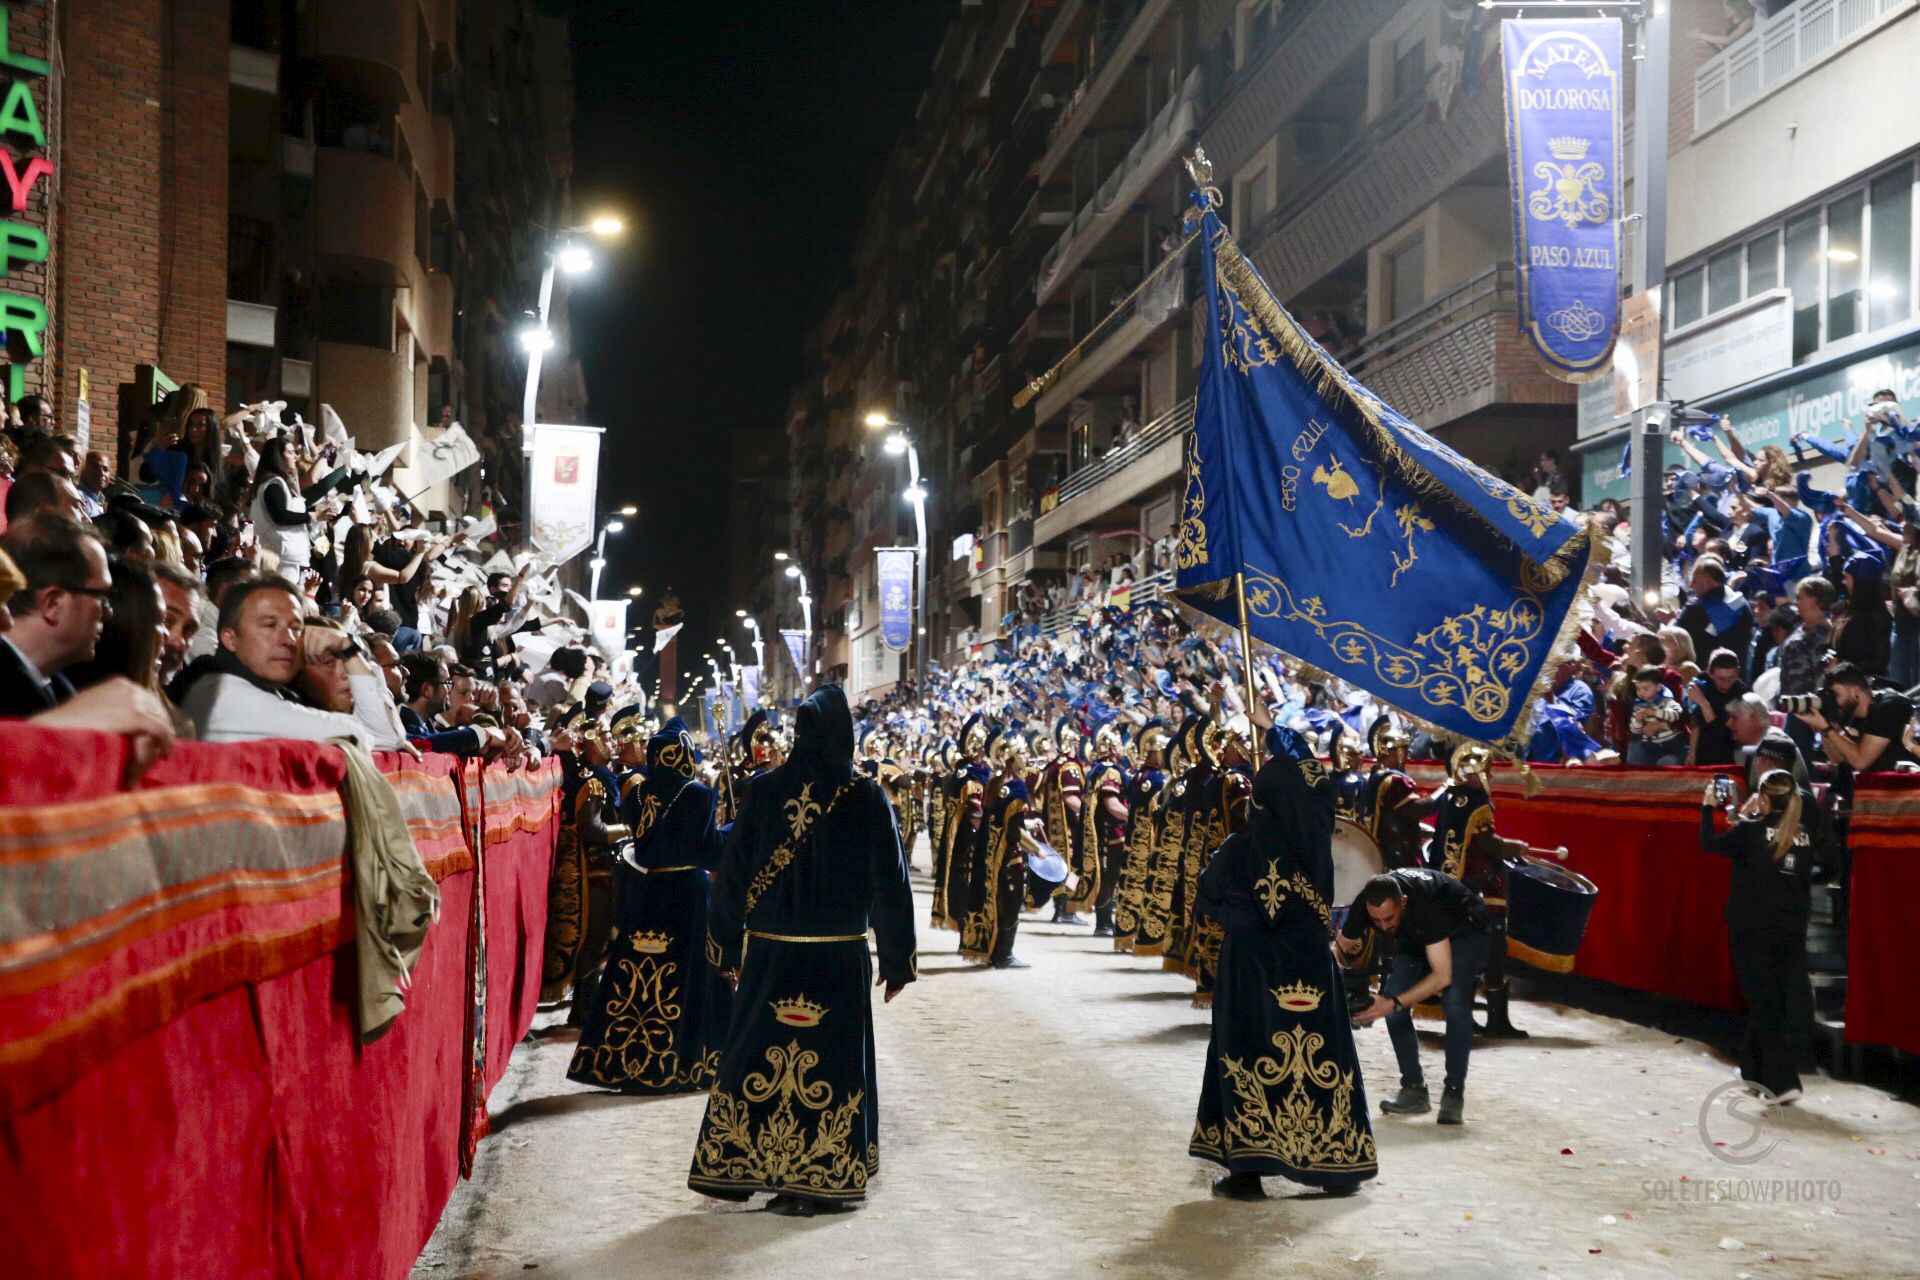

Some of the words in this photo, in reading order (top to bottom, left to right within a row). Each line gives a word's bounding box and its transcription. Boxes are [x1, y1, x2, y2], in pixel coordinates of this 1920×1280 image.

[1526, 44, 1602, 80] MATER
[1519, 89, 1612, 110] DOLOROSA
[1530, 246, 1571, 267] PASO
[1573, 248, 1615, 270] AZUL
[1788, 390, 1844, 437] Virgen
[1281, 465, 1301, 512] PASO
[1292, 418, 1329, 462] AZUL
